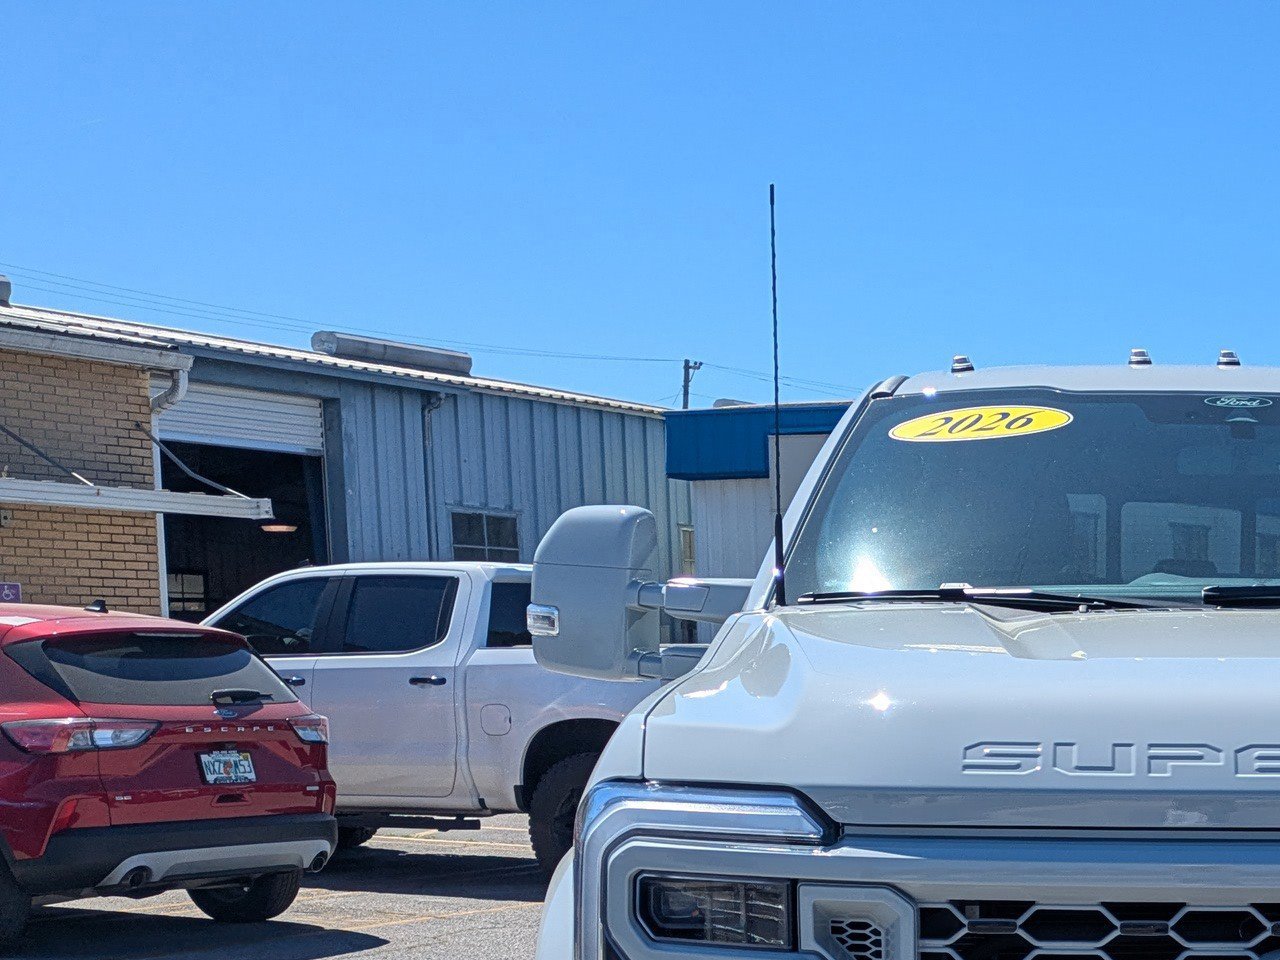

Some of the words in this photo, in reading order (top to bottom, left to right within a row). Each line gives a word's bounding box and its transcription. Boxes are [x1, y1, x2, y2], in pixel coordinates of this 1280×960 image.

[1216, 396, 1260, 407] Ford
[913, 410, 1046, 438] 2026
[185, 725, 275, 733] ESCAPE
